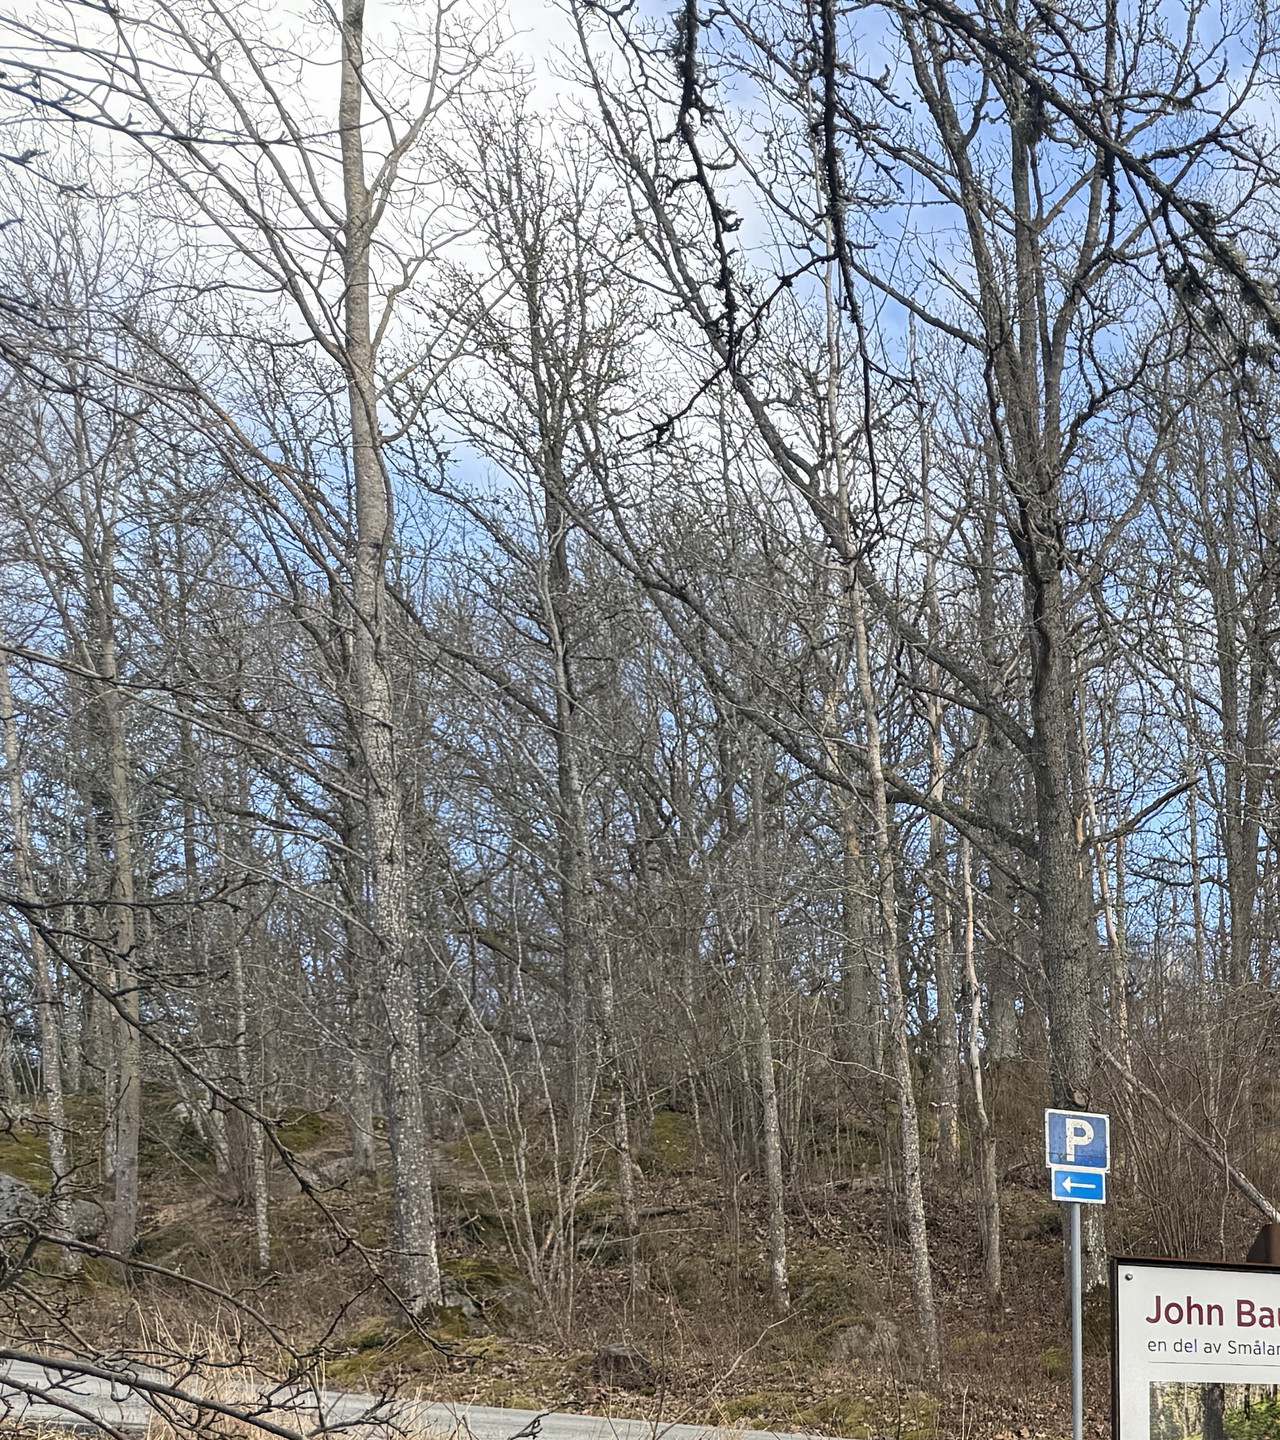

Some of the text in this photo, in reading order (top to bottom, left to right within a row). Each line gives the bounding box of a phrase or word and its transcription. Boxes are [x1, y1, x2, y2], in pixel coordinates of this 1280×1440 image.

[1065, 1118, 1094, 1162] P
[1145, 1295, 1224, 1326] John
[1147, 1340, 1167, 1352] en
[1173, 1338, 1197, 1353] del
[1203, 1342, 1222, 1354] av
